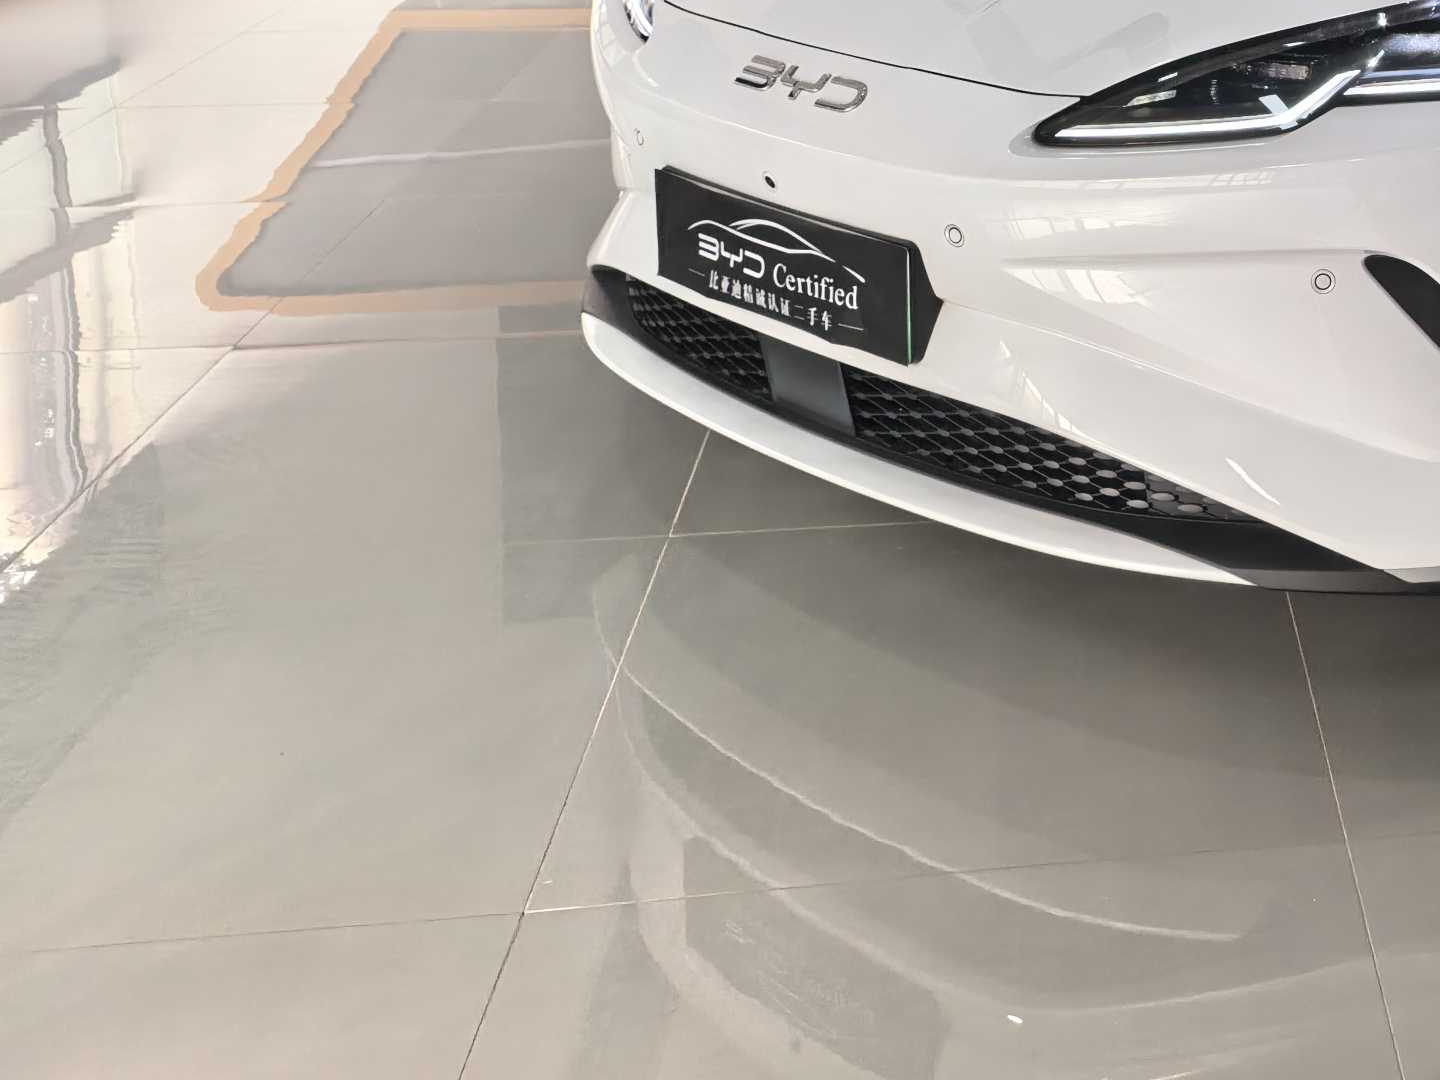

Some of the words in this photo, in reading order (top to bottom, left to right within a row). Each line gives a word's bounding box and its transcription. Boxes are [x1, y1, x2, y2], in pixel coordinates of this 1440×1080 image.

[734, 55, 869, 113] BYD
[698, 233, 765, 279] BYD
[773, 263, 858, 310] Certified
[709, 270, 832, 331] 比亚迪精诚认证二手车
